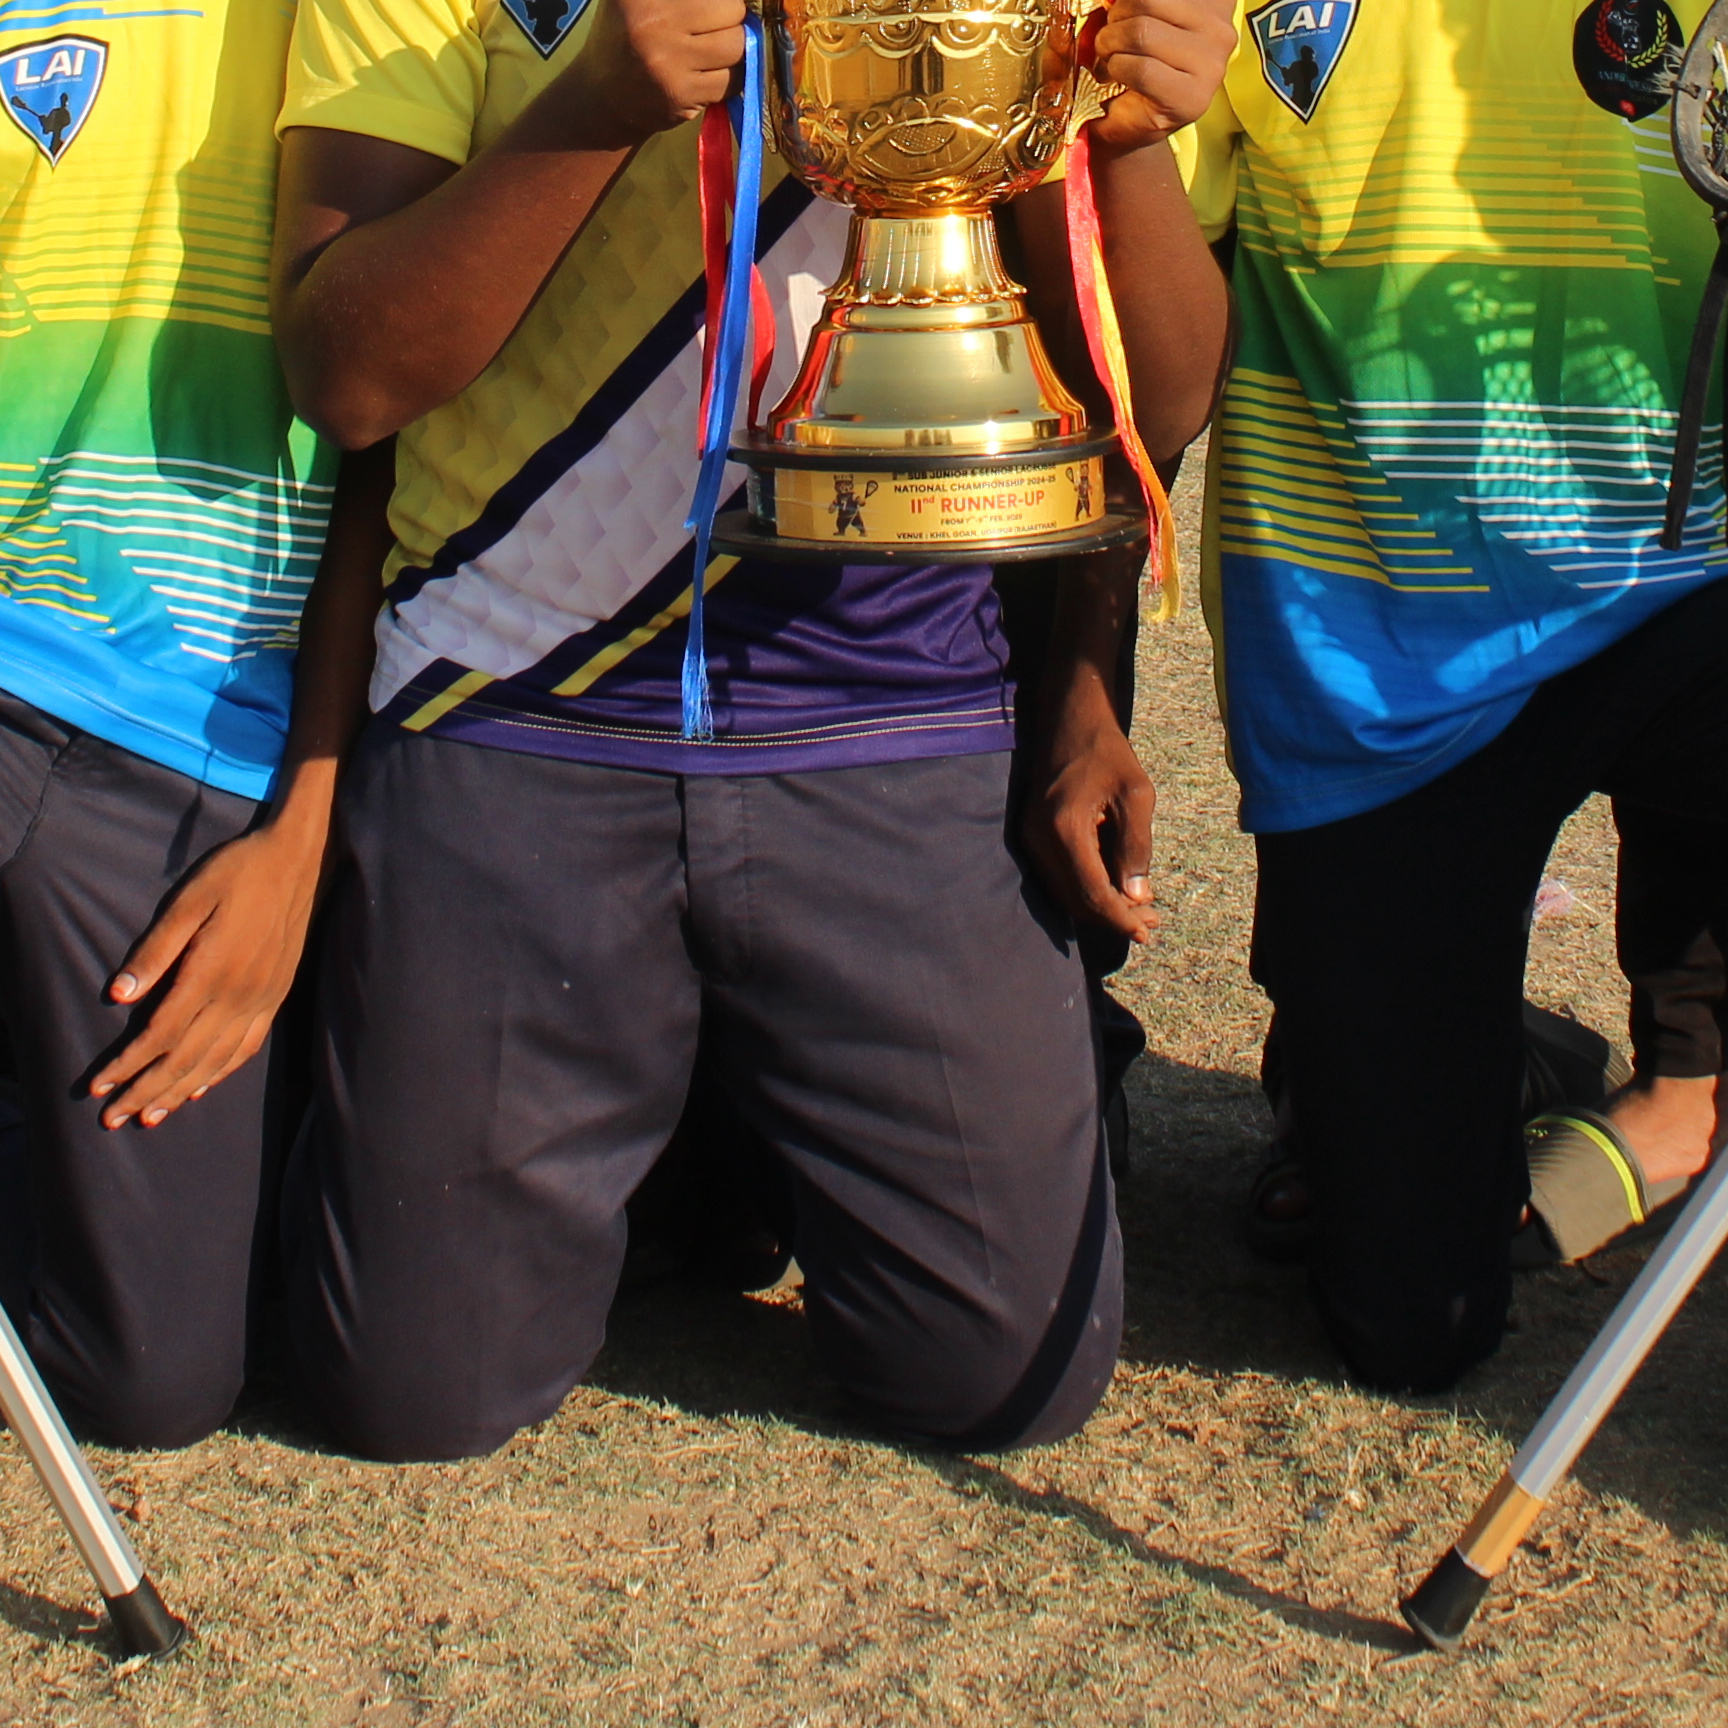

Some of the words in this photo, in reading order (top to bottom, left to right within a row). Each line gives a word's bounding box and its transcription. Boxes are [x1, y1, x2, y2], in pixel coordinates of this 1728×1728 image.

[1268, 1, 1335, 39] LAI
[14, 49, 86, 85] LAI
[907, 470, 928, 480] SUB
[929, 467, 969, 480] JUNIOR
[894, 483, 948, 493] NATIONAL
[949, 478, 1025, 492] CHAMPIONSHIP
[1026, 474, 1057, 486] 2024-25
[940, 489, 1046, 514] RUNNER-UP
[940, 517, 965, 526] FROM
[895, 532, 924, 540] VENUE
[929, 531, 952, 539] KHEL
